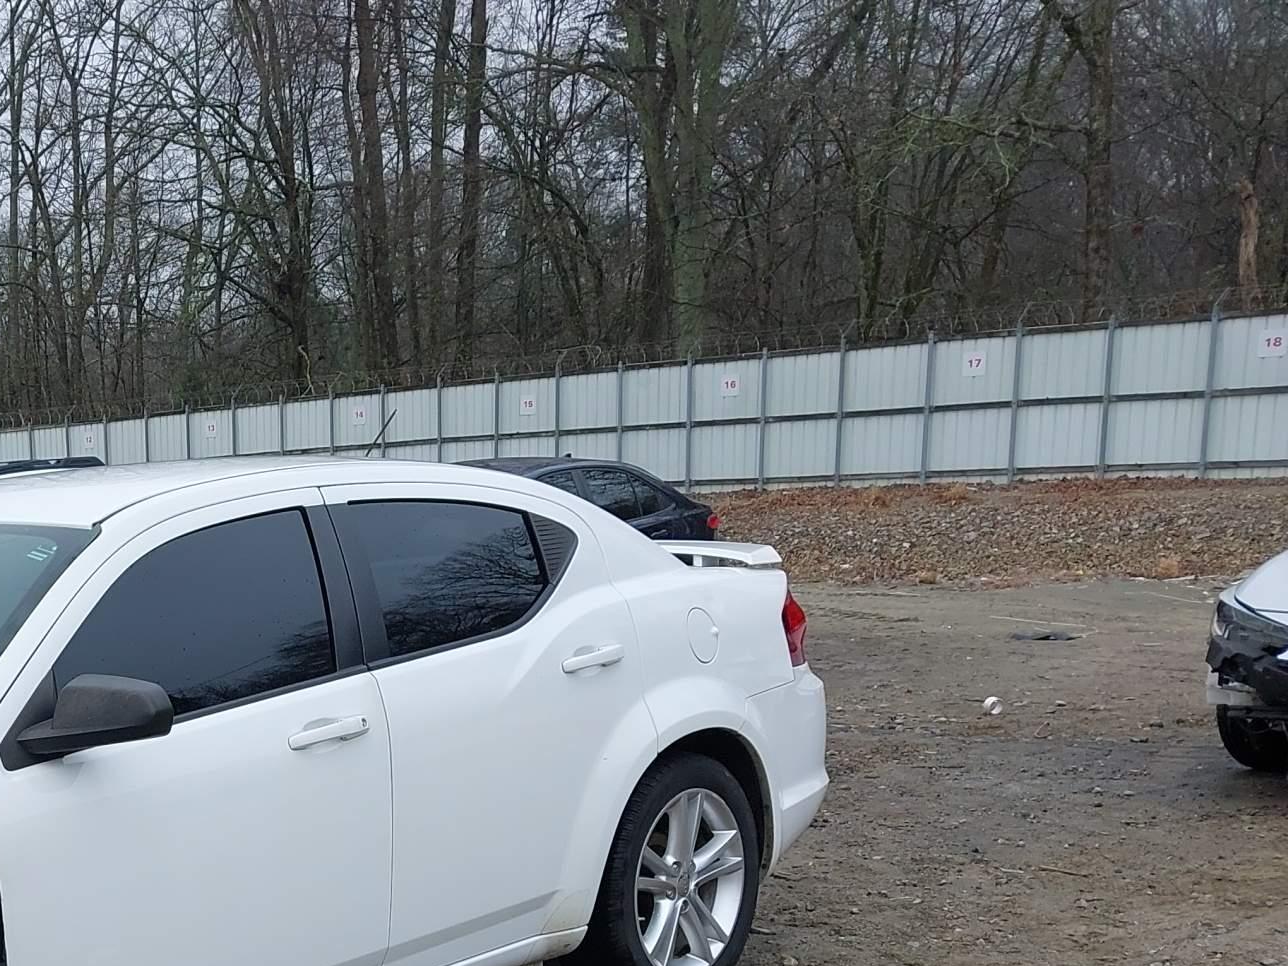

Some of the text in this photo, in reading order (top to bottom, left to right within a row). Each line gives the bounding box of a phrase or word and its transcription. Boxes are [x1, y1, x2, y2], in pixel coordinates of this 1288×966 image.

[1265, 336, 1282, 348] 18
[968, 358, 982, 368] 17
[724, 380, 737, 389] 16
[523, 400, 533, 408] 15
[355, 411, 363, 419] 14
